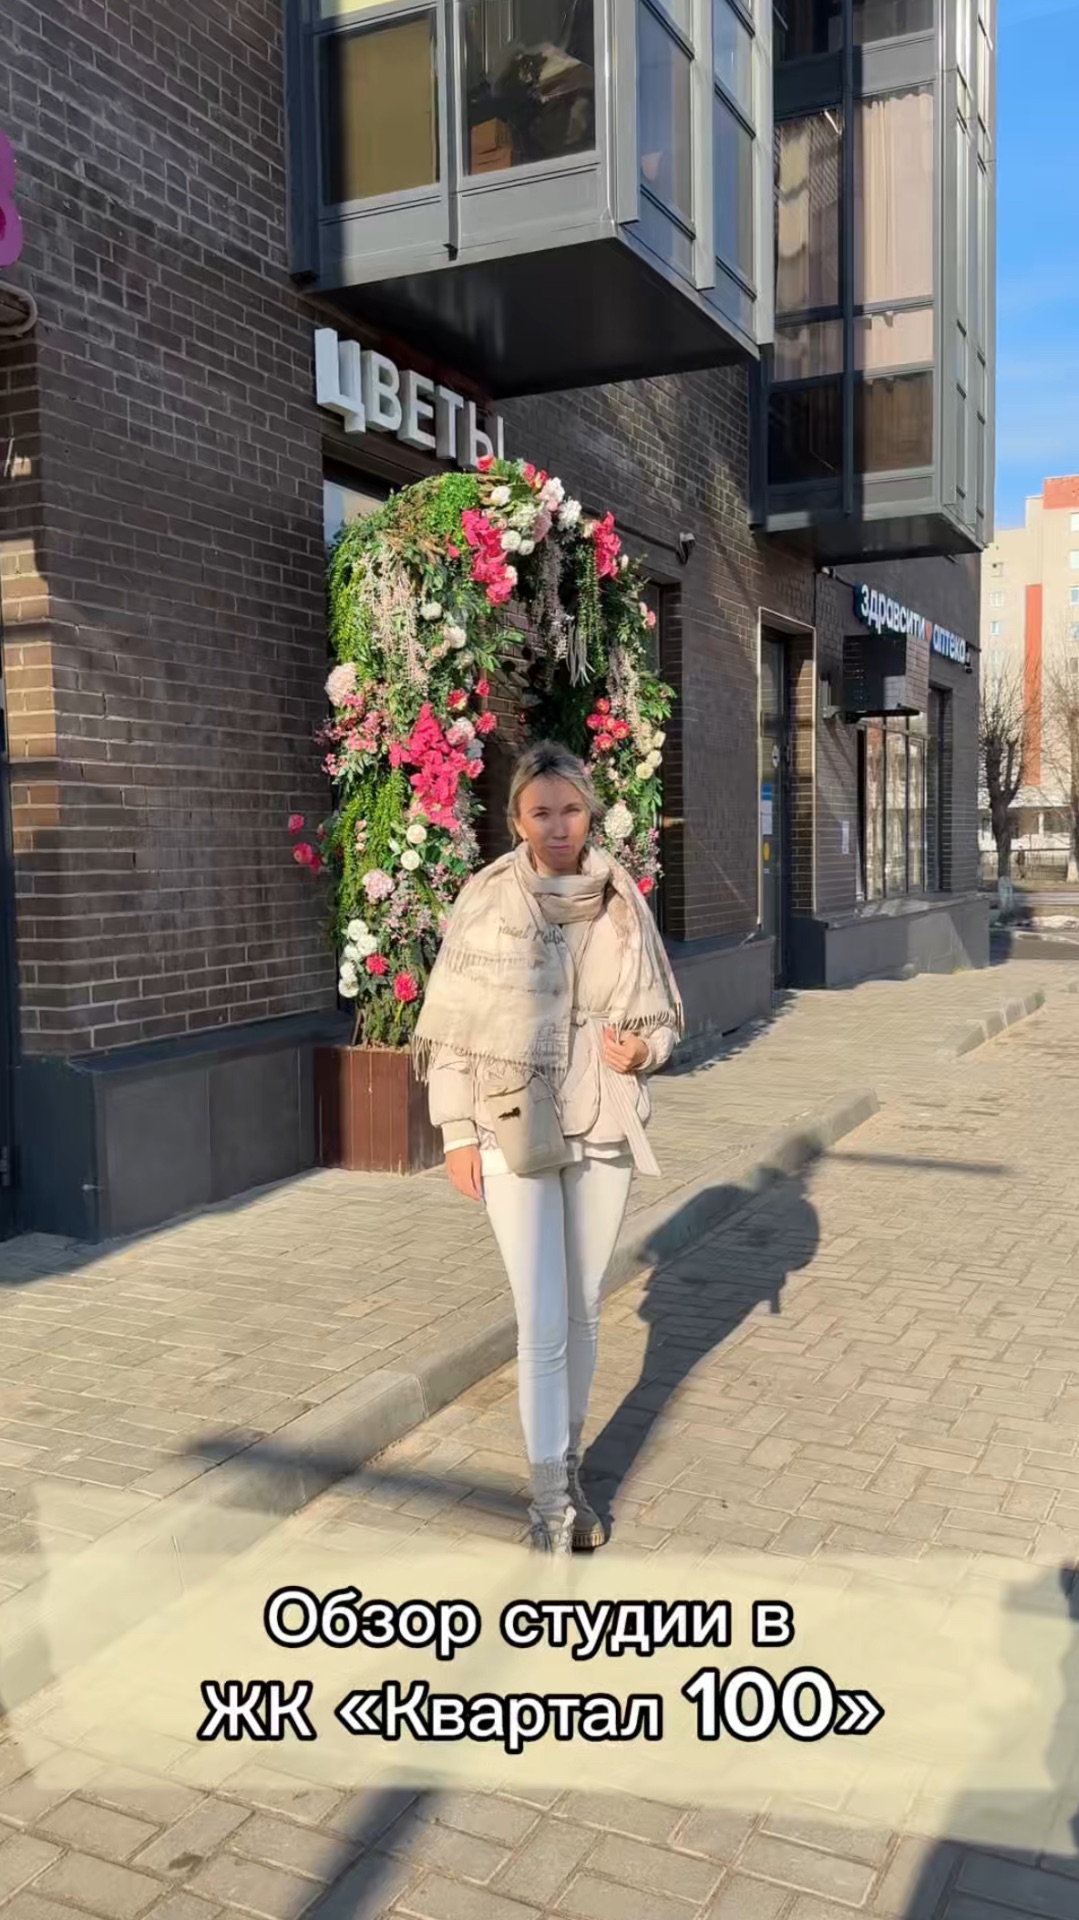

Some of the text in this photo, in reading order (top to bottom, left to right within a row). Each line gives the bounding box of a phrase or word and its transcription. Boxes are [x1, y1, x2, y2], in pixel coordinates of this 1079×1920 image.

[314, 327, 504, 469] ЦВЕТЫ
[860, 583, 967, 664] здравсити аптека
